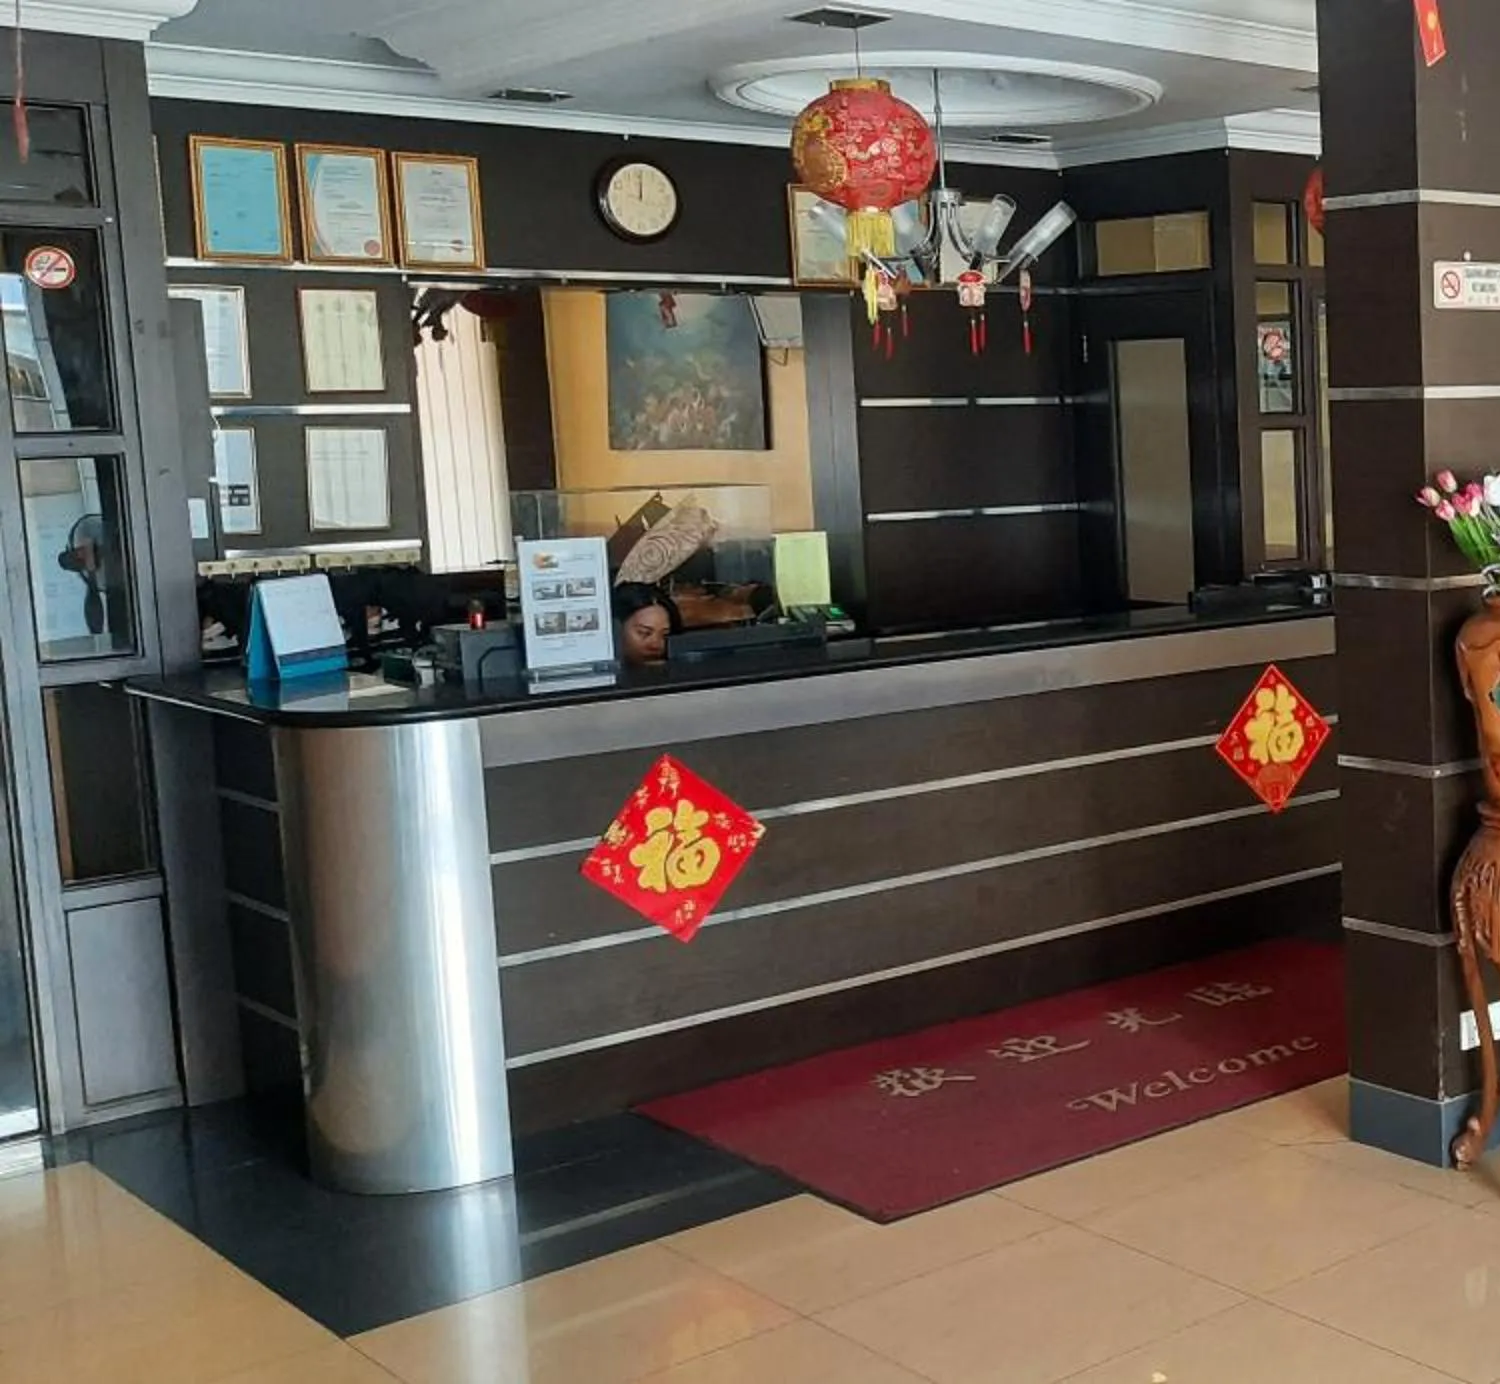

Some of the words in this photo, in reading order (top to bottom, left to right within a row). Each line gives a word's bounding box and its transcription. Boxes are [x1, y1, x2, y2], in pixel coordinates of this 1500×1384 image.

[1244, 683, 1304, 765] 福
[629, 799, 721, 893] 福
[1065, 1035, 1319, 1113] Welcome
